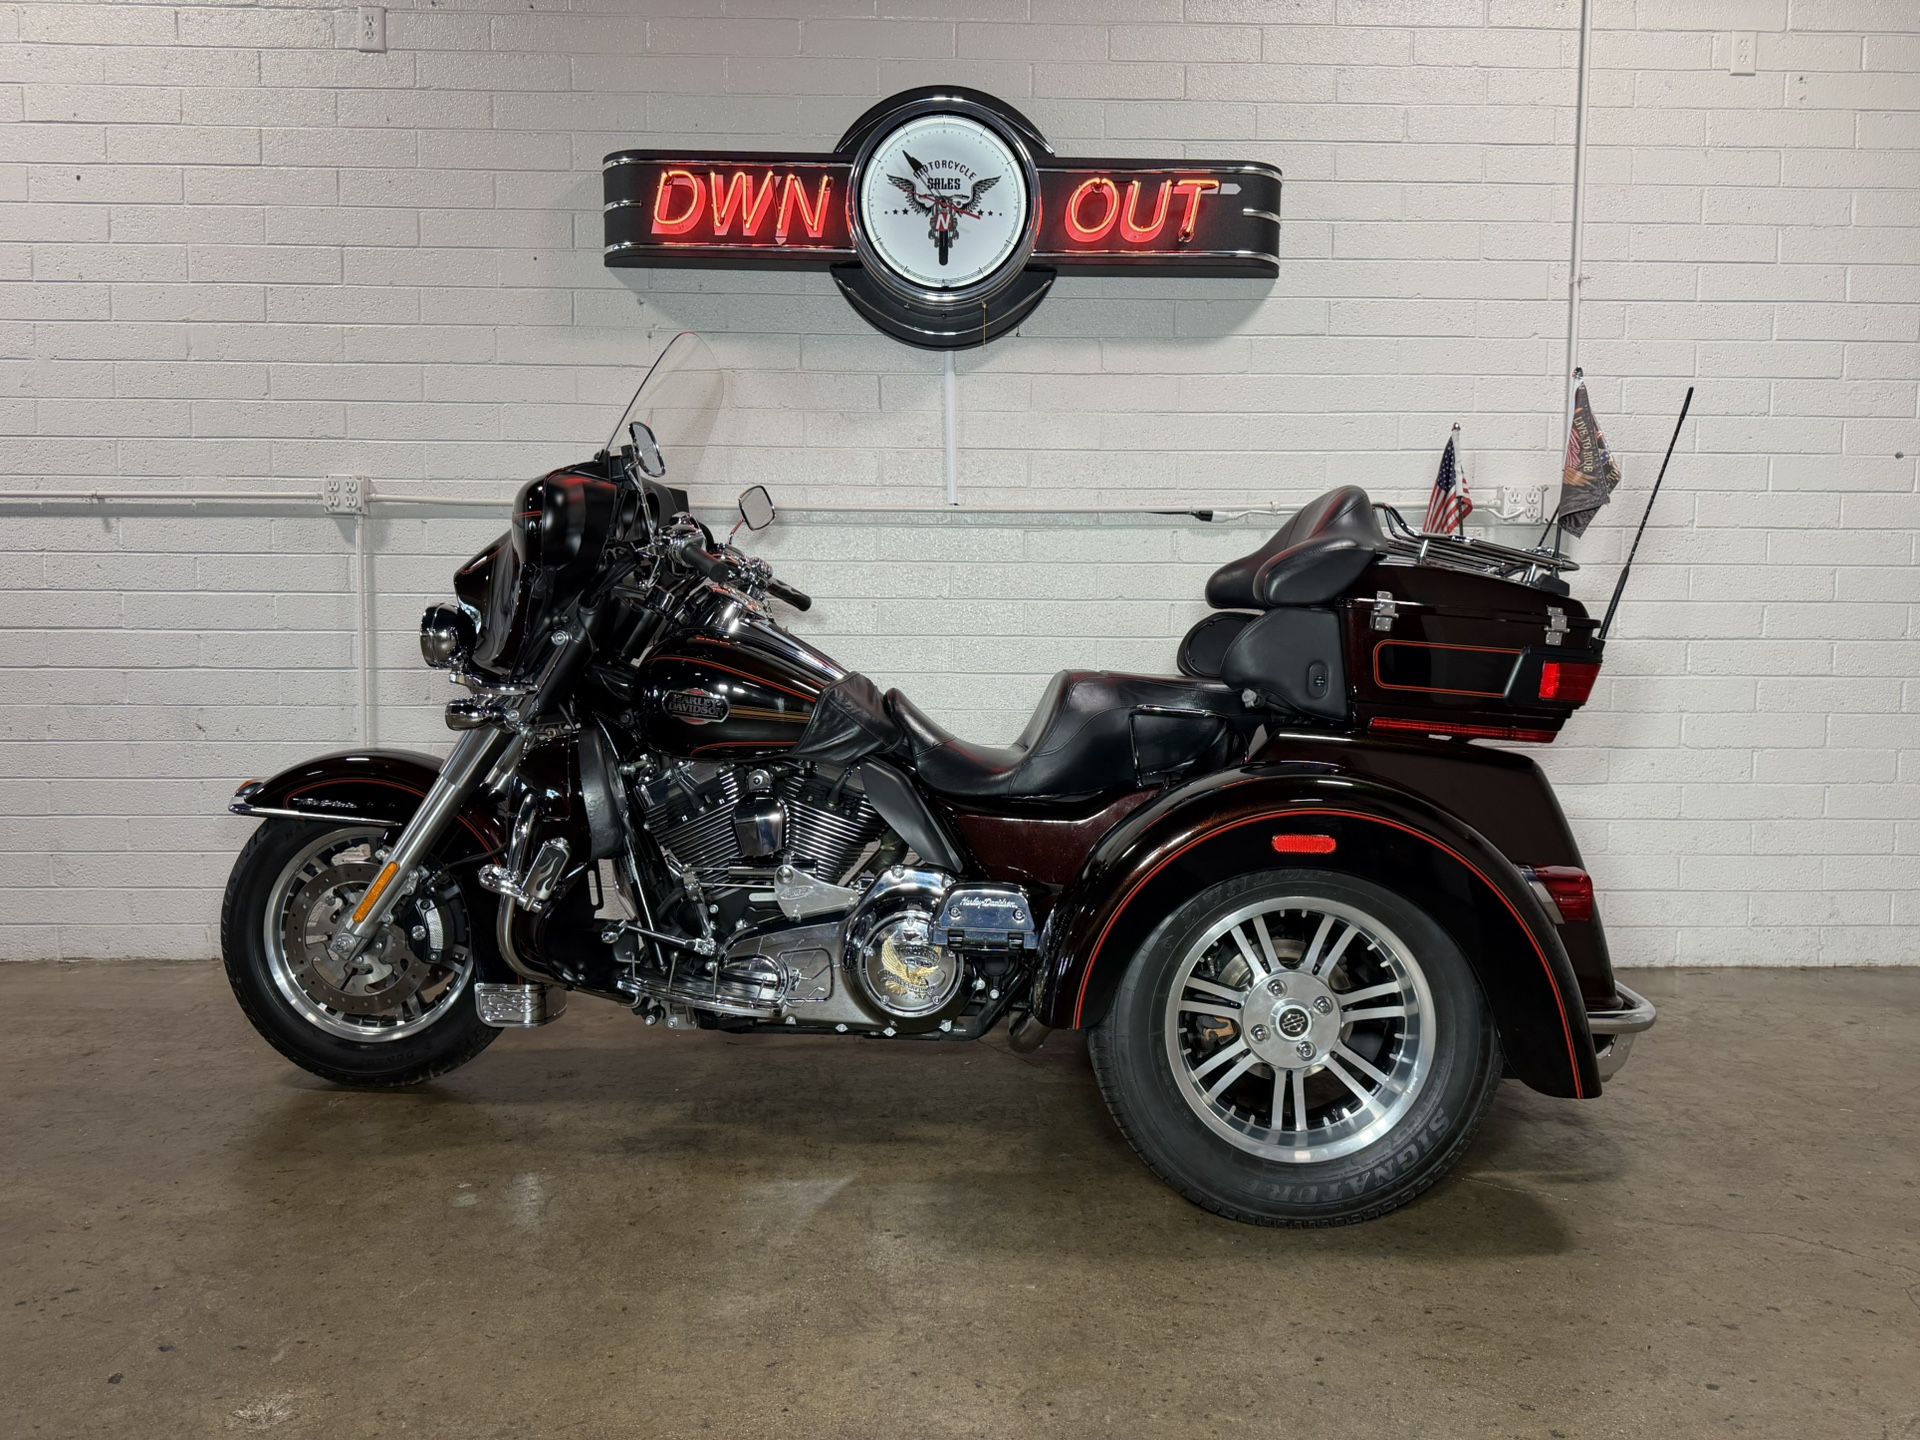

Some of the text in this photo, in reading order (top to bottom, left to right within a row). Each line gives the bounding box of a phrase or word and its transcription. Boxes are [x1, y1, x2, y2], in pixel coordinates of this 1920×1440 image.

[913, 159, 977, 180] MOTORCYCLE
[927, 178, 961, 190] SALES
[651, 170, 1220, 243] DWN OUT
[1574, 416, 1593, 472] LIVE TO RIDE
